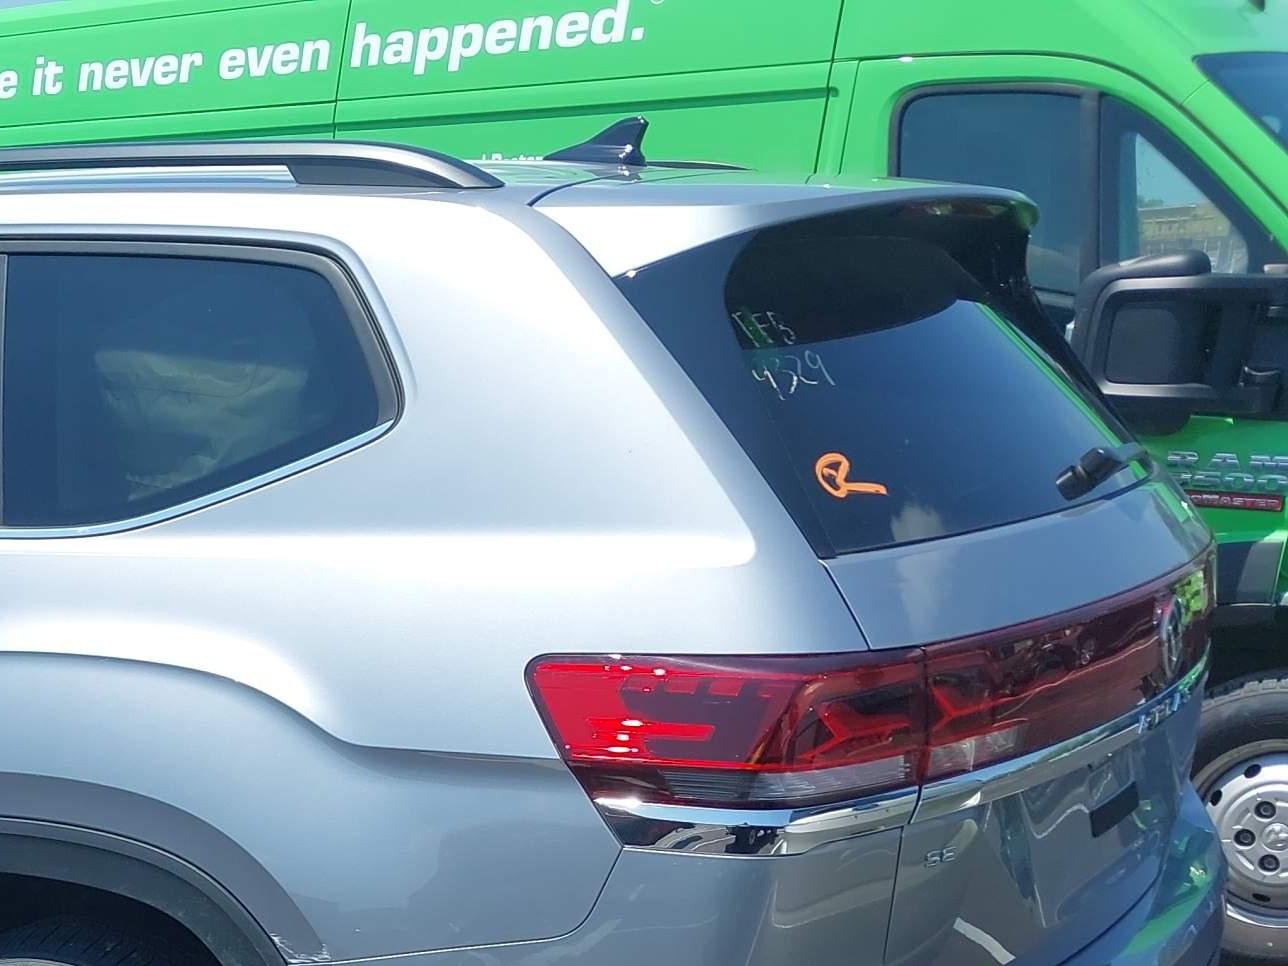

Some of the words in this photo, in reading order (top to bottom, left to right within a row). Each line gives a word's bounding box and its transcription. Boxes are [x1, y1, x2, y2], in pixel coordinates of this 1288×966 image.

[32, 56, 64, 96] it
[78, 52, 203, 92] never
[219, 39, 330, 80] even
[350, 0, 644, 75] happened.
